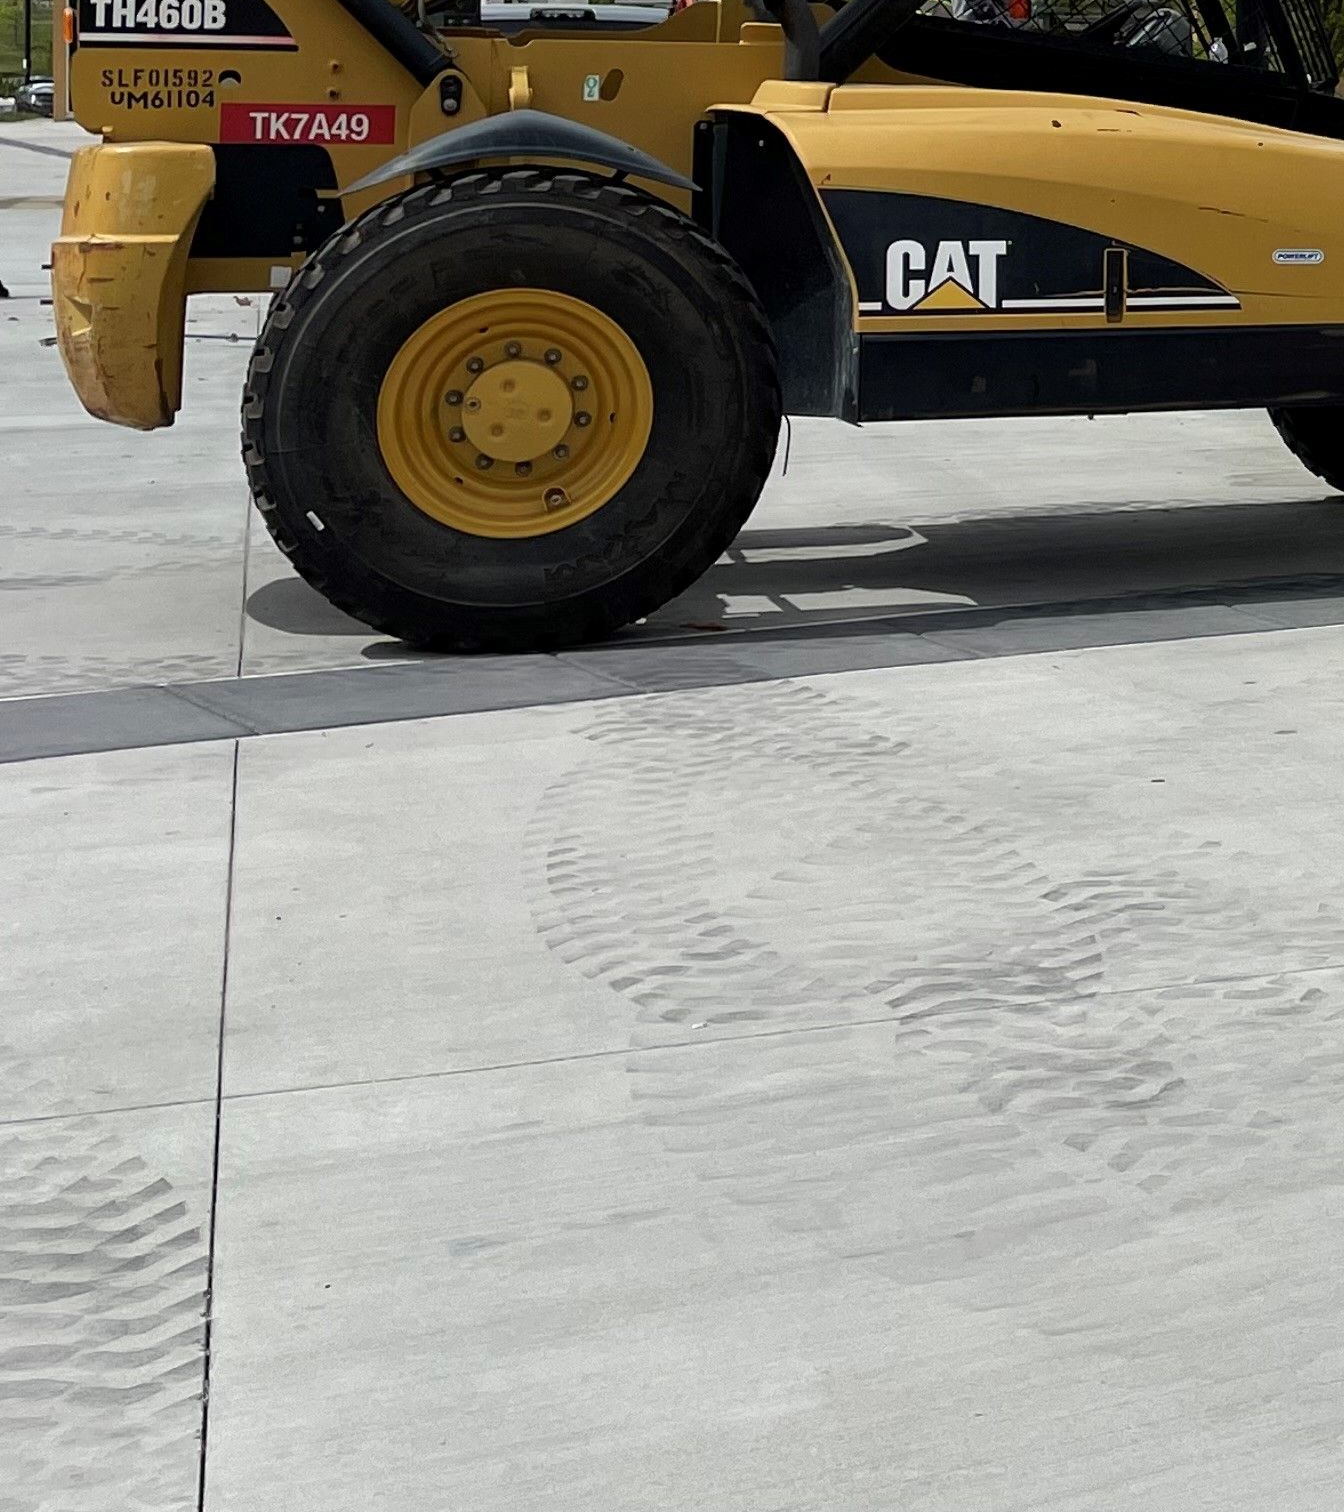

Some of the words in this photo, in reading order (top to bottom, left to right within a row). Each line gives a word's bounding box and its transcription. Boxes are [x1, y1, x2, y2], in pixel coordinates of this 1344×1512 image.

[101, 68, 213, 88] SLF01592
[110, 90, 215, 110] UM61104
[249, 111, 370, 142] TK7A49
[886, 239, 1007, 311] CAT
